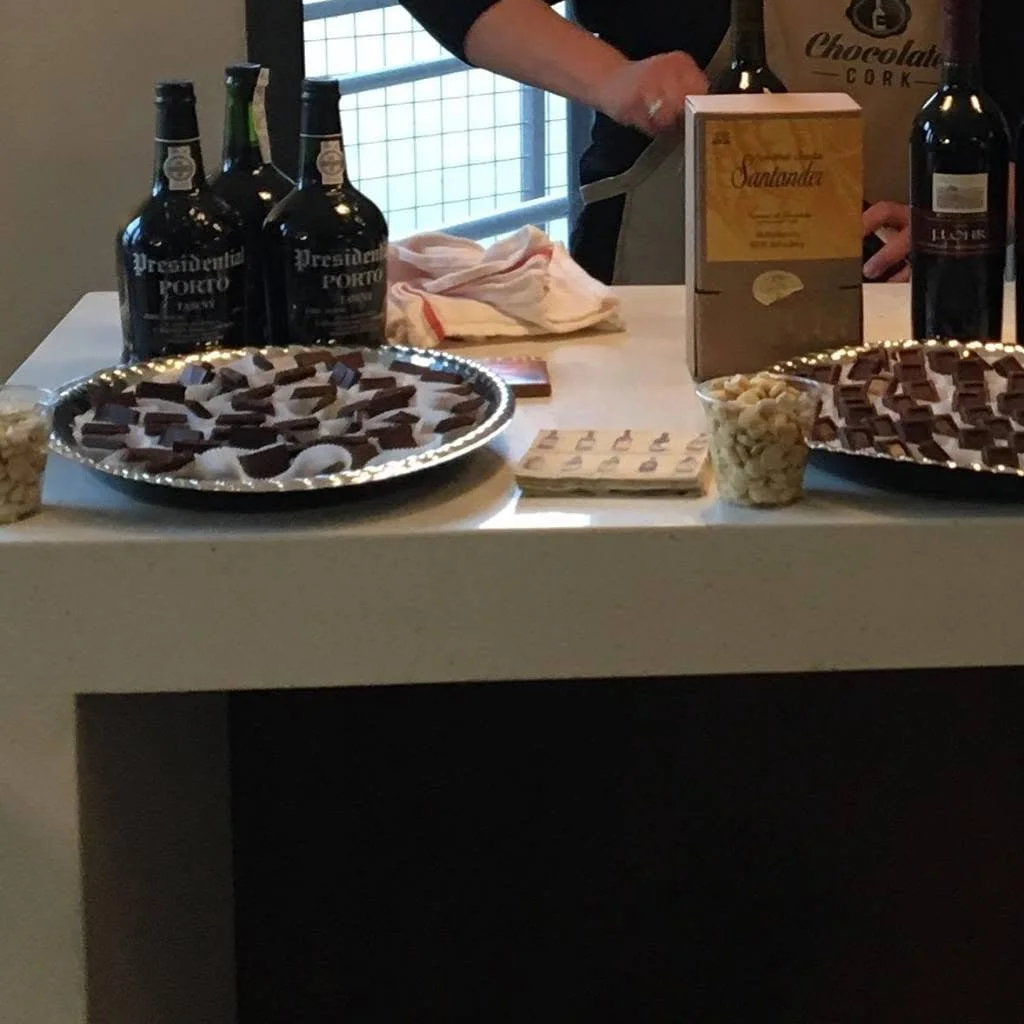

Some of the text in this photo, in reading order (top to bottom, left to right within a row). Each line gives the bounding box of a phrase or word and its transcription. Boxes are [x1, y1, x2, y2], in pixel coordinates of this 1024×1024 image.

[846, 67, 911, 89] CORK
[731, 154, 824, 189] Santander
[132, 244, 245, 277] Presidential
[159, 275, 230, 297] PORTO
[322, 267, 384, 290] PORTO
